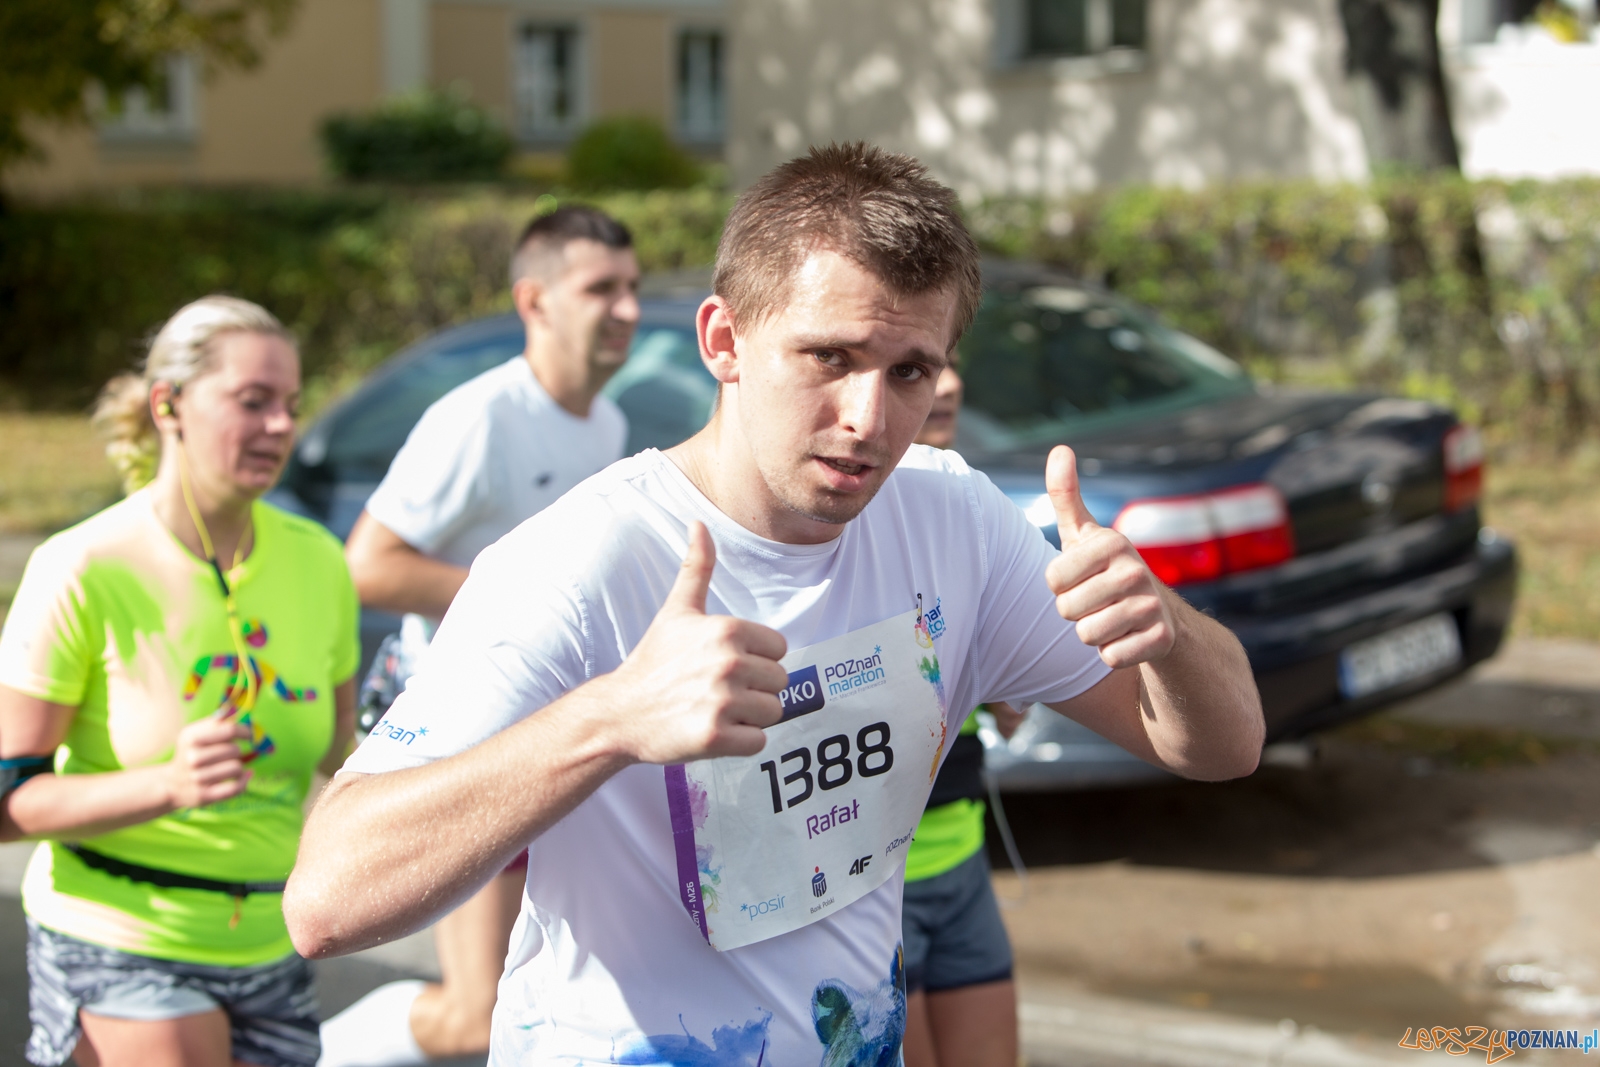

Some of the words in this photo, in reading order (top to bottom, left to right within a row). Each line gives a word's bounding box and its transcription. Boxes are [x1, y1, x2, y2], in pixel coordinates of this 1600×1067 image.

[778, 680, 815, 708] PKO
[829, 667, 885, 695] maraton
[760, 721, 894, 814] 1388
[806, 799, 860, 839] Rafał
[848, 854, 873, 876] 4F
[686, 881, 697, 903] M26
